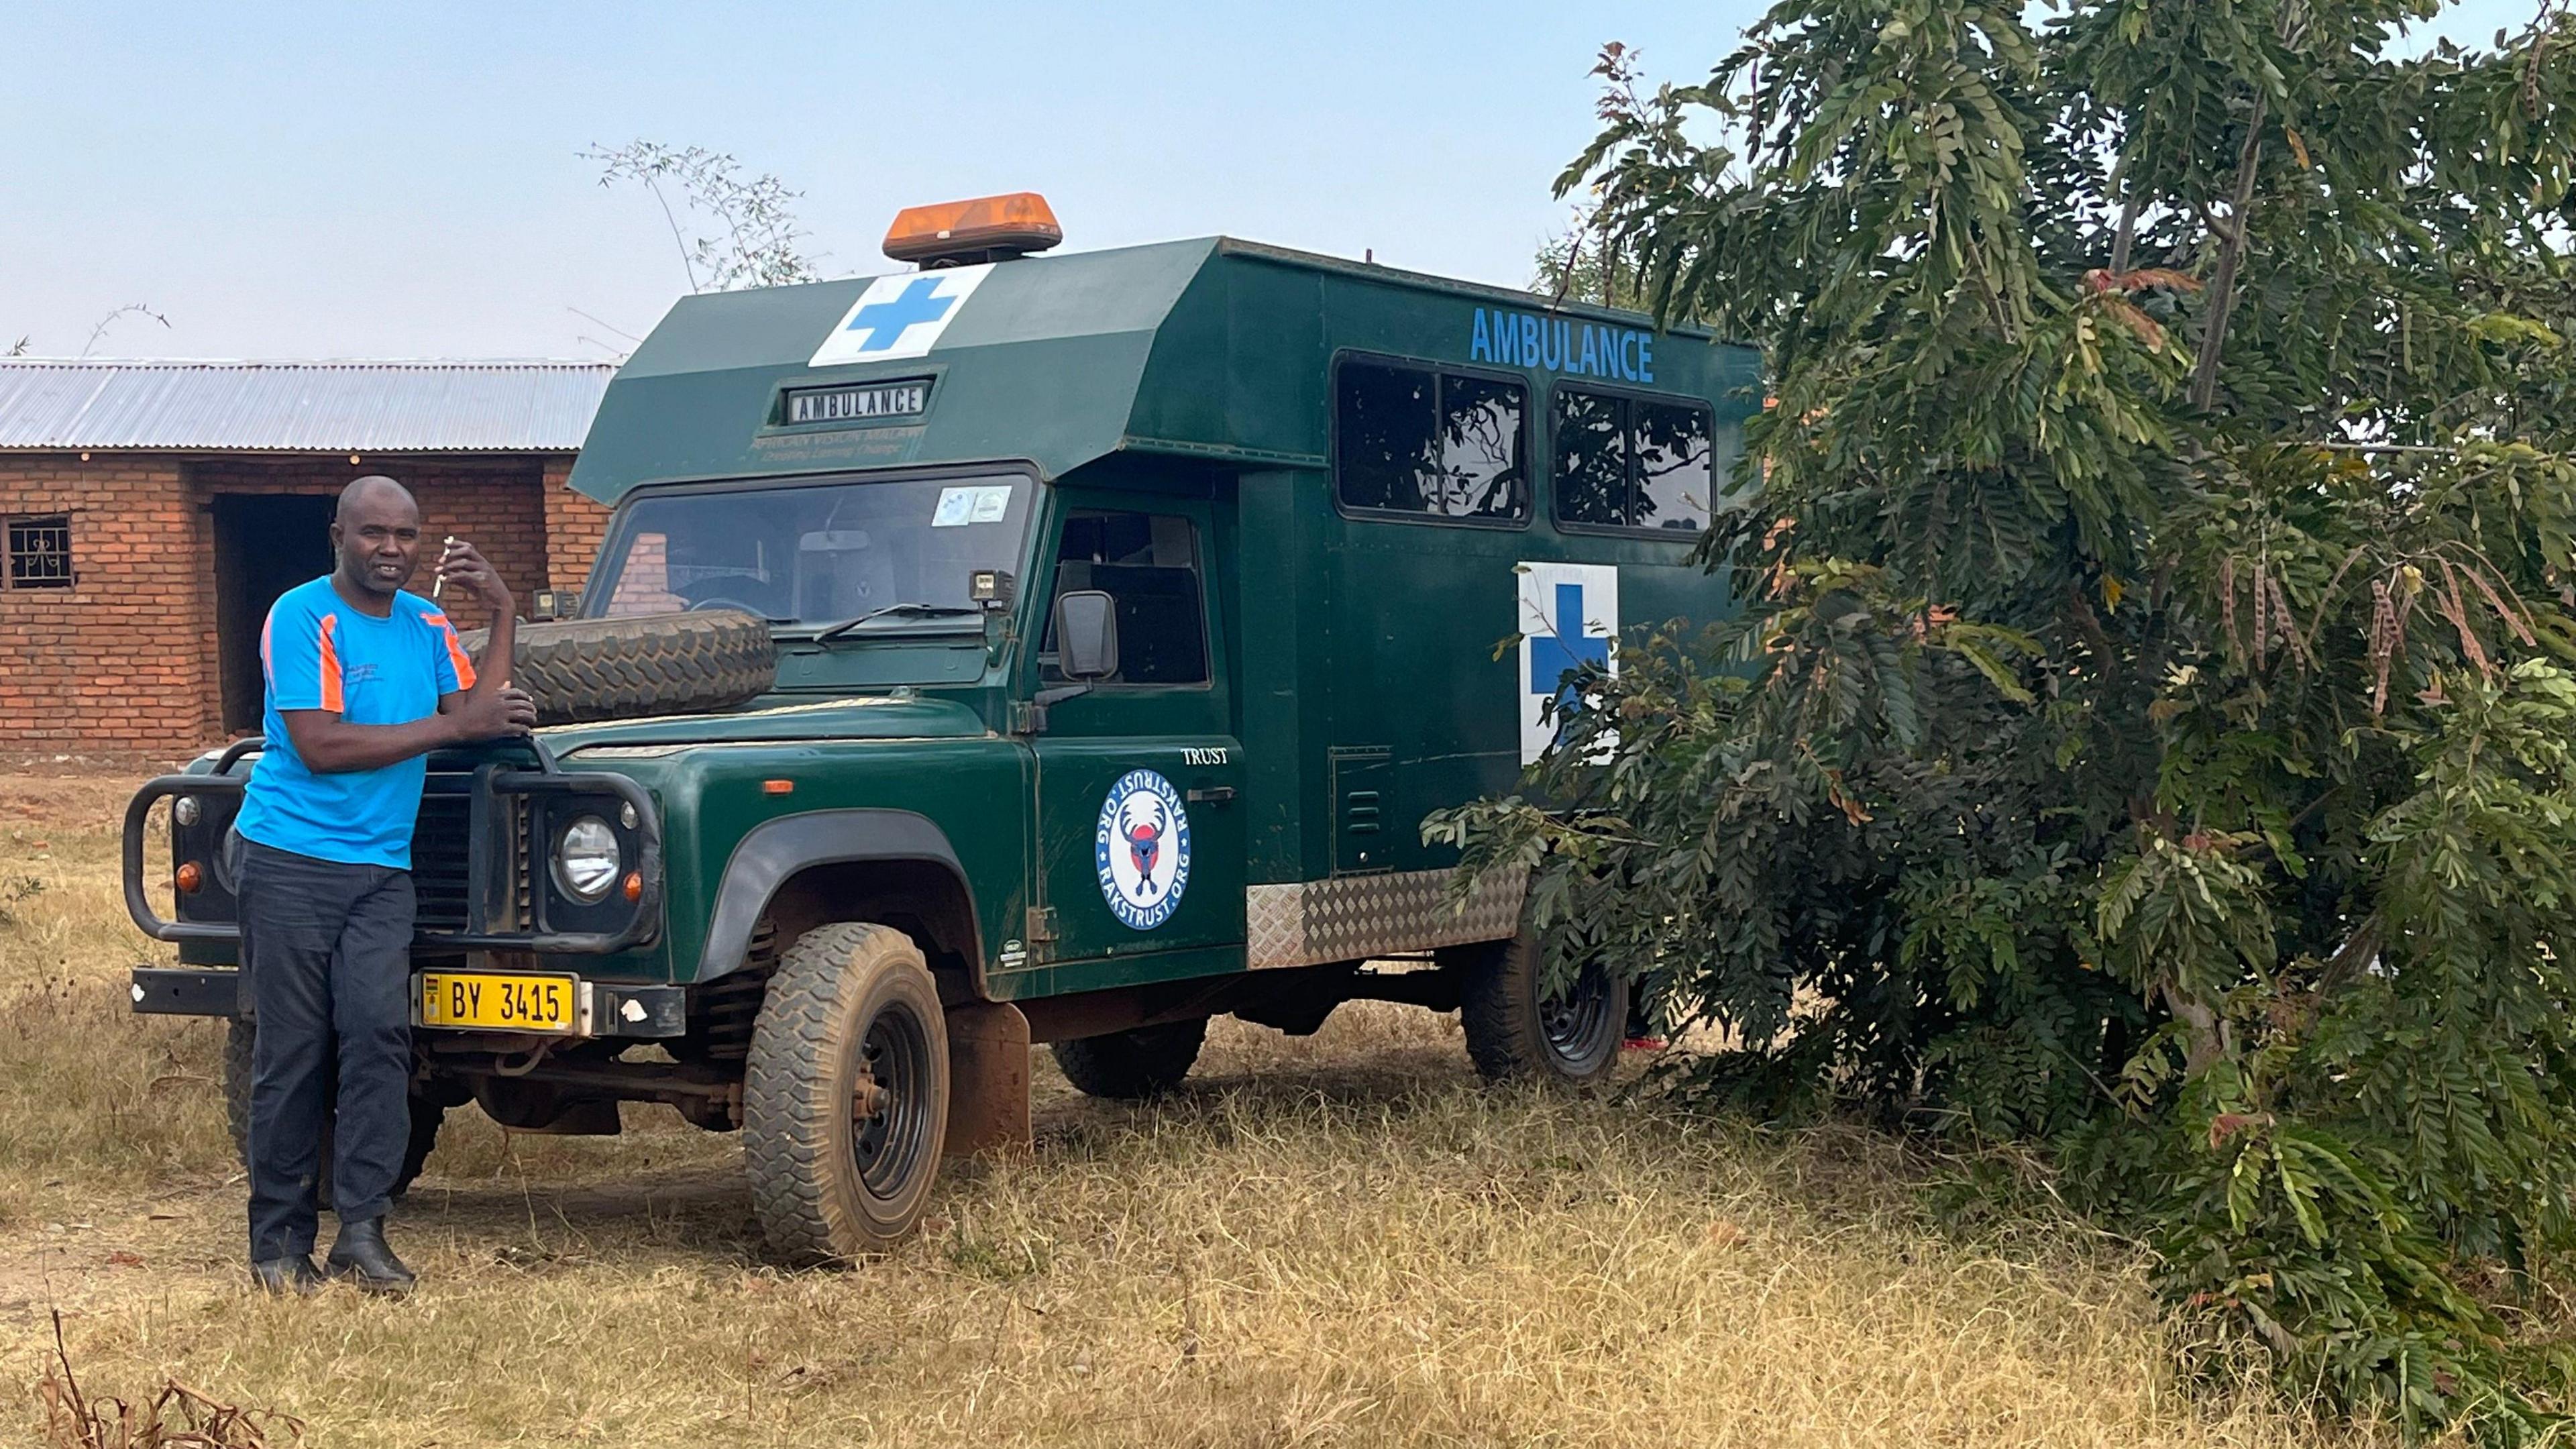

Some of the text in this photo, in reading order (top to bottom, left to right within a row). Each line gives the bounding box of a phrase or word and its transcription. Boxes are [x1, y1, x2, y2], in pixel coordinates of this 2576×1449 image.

[1470, 308, 1653, 383] AMBULANCE
[800, 388, 917, 419] AMBULANCE
[1180, 747, 1227, 765] TRUST
[1098, 771, 1187, 844] RAKSTRUST.ORG
[1100, 853, 1189, 926] RAKSTRUST.ORG
[452, 981, 559, 1022] BY 3415
